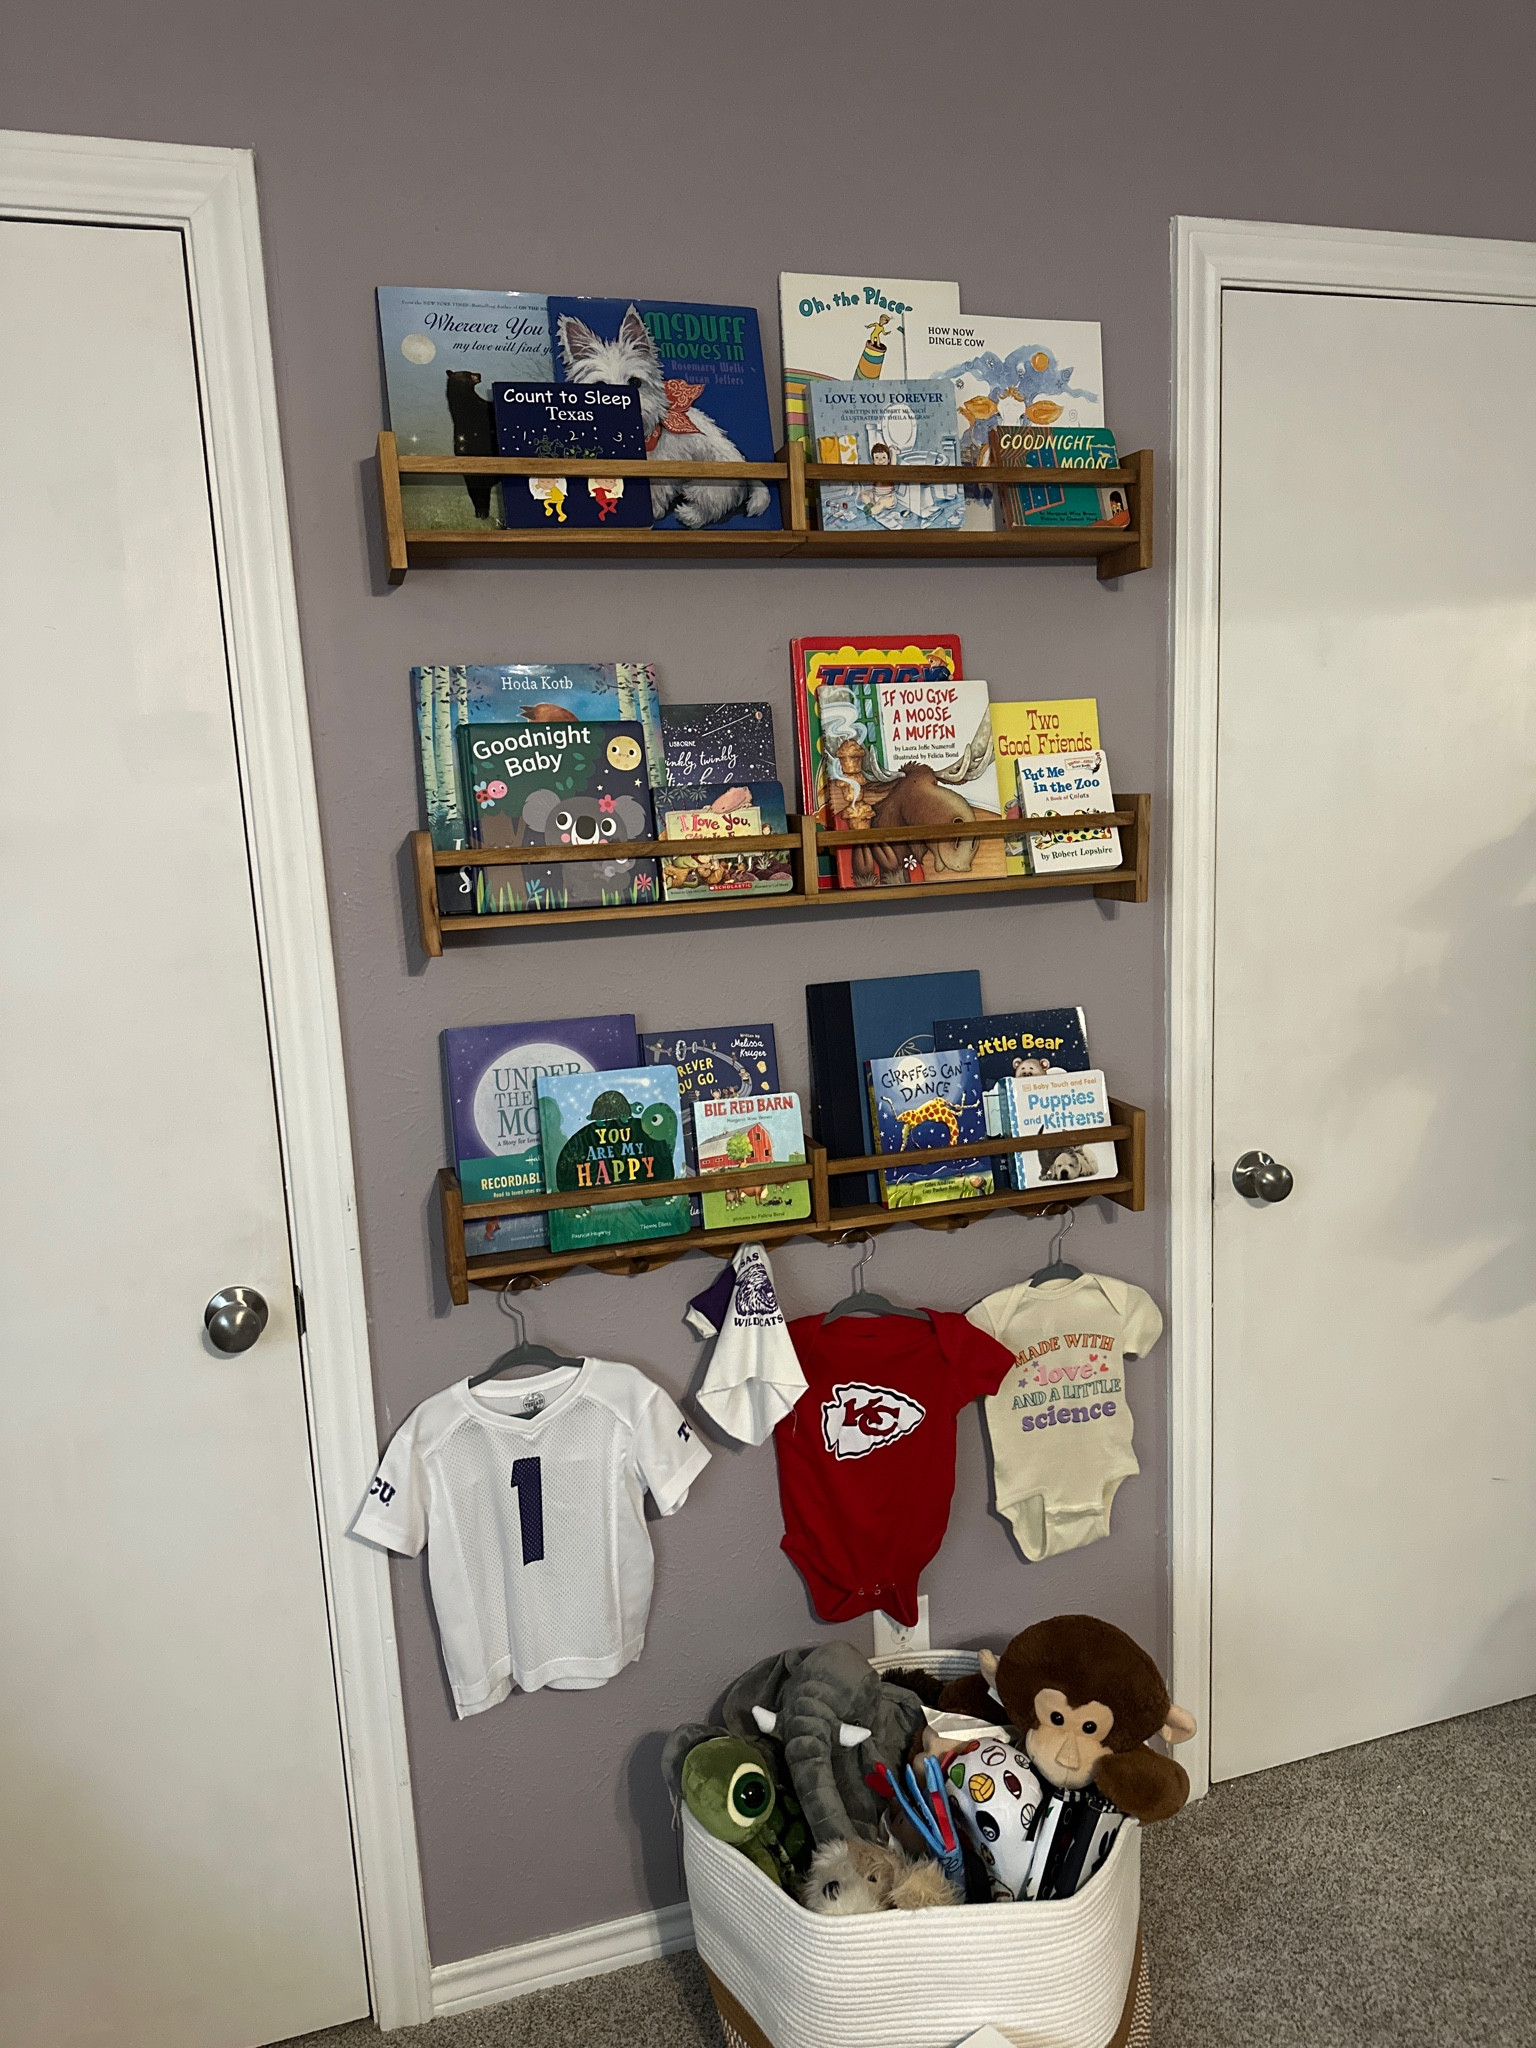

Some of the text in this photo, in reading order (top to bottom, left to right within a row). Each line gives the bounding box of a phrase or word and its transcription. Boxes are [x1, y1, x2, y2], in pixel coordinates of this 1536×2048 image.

[799, 297, 831, 317] Oh,
[833, 291, 860, 306] the
[424, 312, 543, 340] Wherever You
[928, 327, 974, 336] HOW NOW
[452, 342, 470, 353] my
[472, 340, 493, 350] love
[494, 341, 517, 352] will
[512, 342, 542, 356] find
[929, 336, 985, 347] DINGLE COW
[719, 362, 745, 373] Wells
[503, 388, 631, 410] Count to Sleep
[824, 392, 944, 404] LOVE YOU FOREVER
[545, 406, 594, 421] Texas
[1000, 434, 1095, 450] GOODNIGHT
[1060, 456, 1109, 469] MOON
[500, 676, 573, 690] Hoda Kotb
[882, 687, 958, 707] IF YOU GIVE
[893, 706, 951, 724] A MOOSE
[1026, 709, 1059, 730] Two
[893, 723, 955, 741] A MUFFIN
[472, 725, 591, 760] Goodnight
[998, 731, 1093, 756] Good Friends
[504, 751, 562, 777] Baby
[700, 745, 738, 768] twinkly
[893, 753, 919, 761] illustrated
[1021, 766, 1065, 781] Put Me
[1033, 778, 1100, 793] in the Zoo
[677, 813, 751, 832] I Love You,
[1040, 845, 1113, 861] by Robert Lopshire
[730, 1038, 764, 1048] Melissa
[1021, 1033, 1064, 1050] Bear
[739, 1049, 768, 1060] Kruger
[676, 1057, 714, 1077] REVER
[881, 1060, 972, 1089] GIRAFFES CAN'T
[678, 1078, 693, 1094] OU
[899, 1081, 951, 1103] DANCE
[1033, 1083, 1049, 1091] Baby
[1083, 1077, 1097, 1085] Feel
[494, 1090, 532, 1109] THE
[704, 1095, 794, 1117] BIG RED BARN
[1028, 1088, 1095, 1112] Puppies
[497, 1106, 540, 1138] MO
[1023, 1111, 1105, 1129] and Kittens
[594, 1127, 631, 1145] YOU
[586, 1142, 644, 1161] ARE MY
[480, 1171, 542, 1190] RECORDABL
[576, 1156, 654, 1187] HAPPY
[733, 1314, 784, 1327] WILDCATS
[1015, 1333, 1115, 1368] MADE WITH
[1037, 1363, 1093, 1386] love
[1011, 1378, 1122, 1410] AND A LITTLE
[842, 1395, 901, 1437] KC
[1021, 1400, 1116, 1432] science
[510, 1456, 544, 1566] 1
